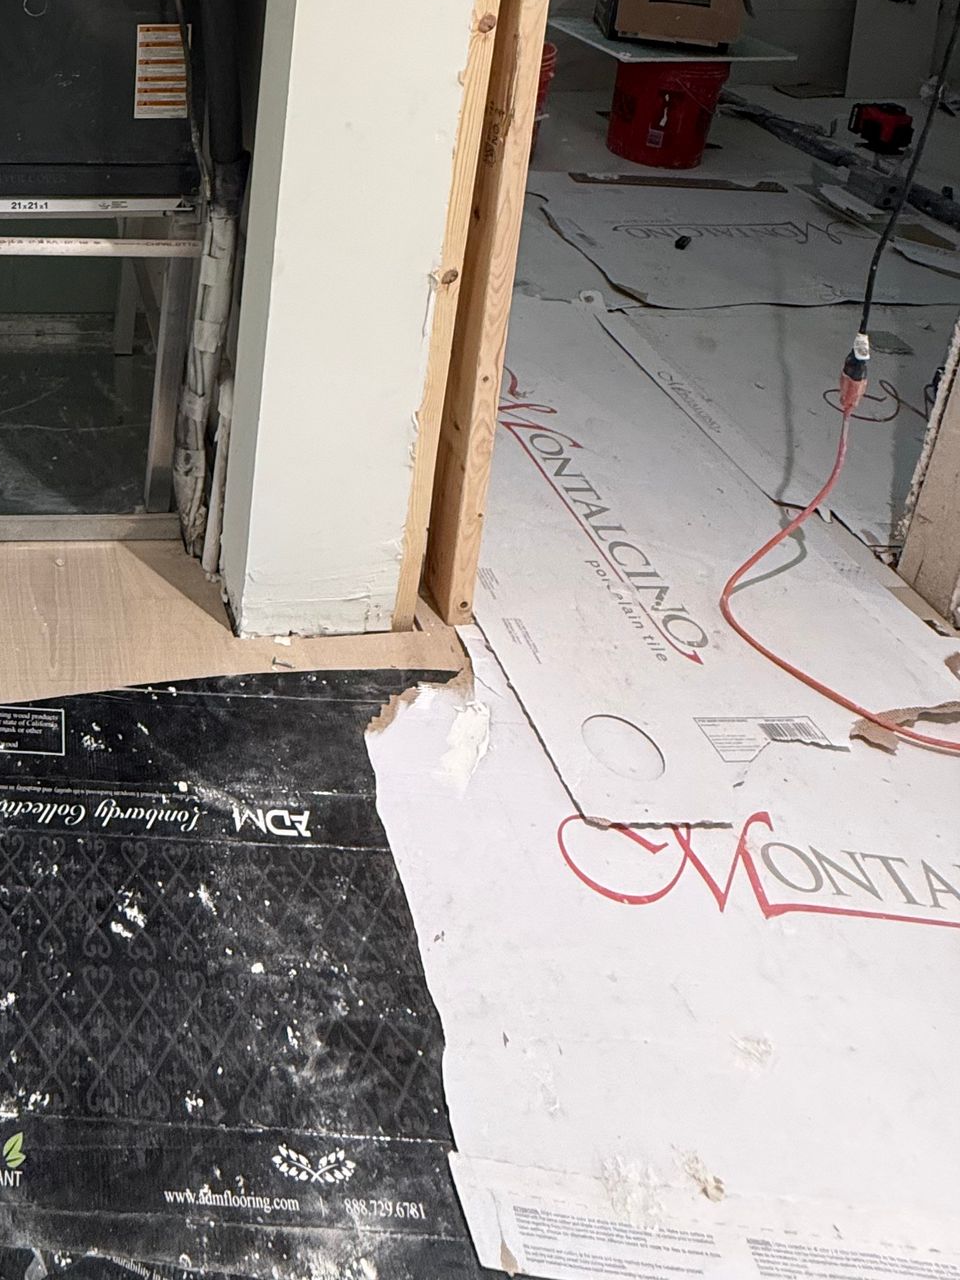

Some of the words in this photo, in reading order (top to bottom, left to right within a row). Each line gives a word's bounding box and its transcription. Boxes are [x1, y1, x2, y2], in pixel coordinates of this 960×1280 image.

[642, 634, 668, 662] tile
[94, 799, 203, 832] Lombardy
[232, 807, 312, 837] ADM
[557, 807, 960, 918] MONTA
[163, 1186, 300, 1212] www.admflooring.com
[343, 1196, 425, 1219] 888.729.6781
